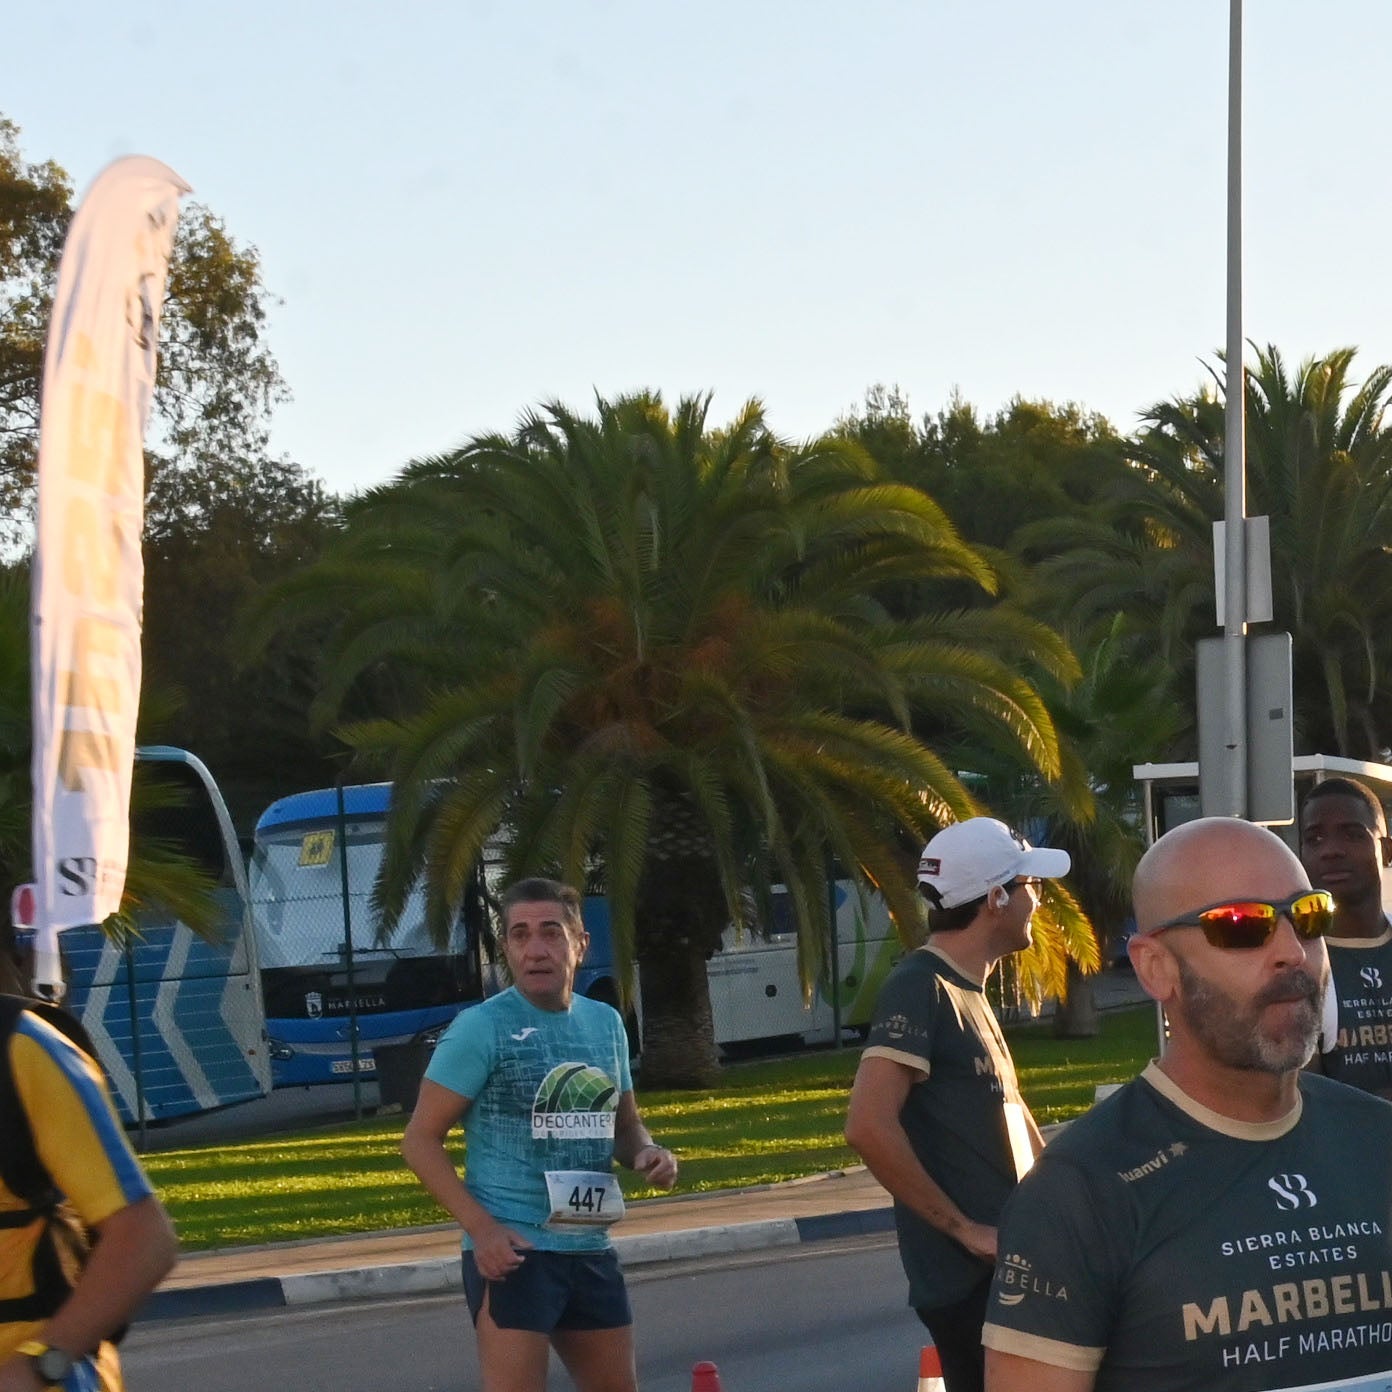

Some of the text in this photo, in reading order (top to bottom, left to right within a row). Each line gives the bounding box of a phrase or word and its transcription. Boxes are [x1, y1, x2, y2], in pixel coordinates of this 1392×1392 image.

[1118, 1149, 1169, 1184] luanvi
[569, 1186, 606, 1213] 447
[1221, 1221, 1382, 1256] SIERRA BLANCA
[1268, 1245, 1358, 1270] ESTATES
[1223, 1336, 1291, 1368] HALF
